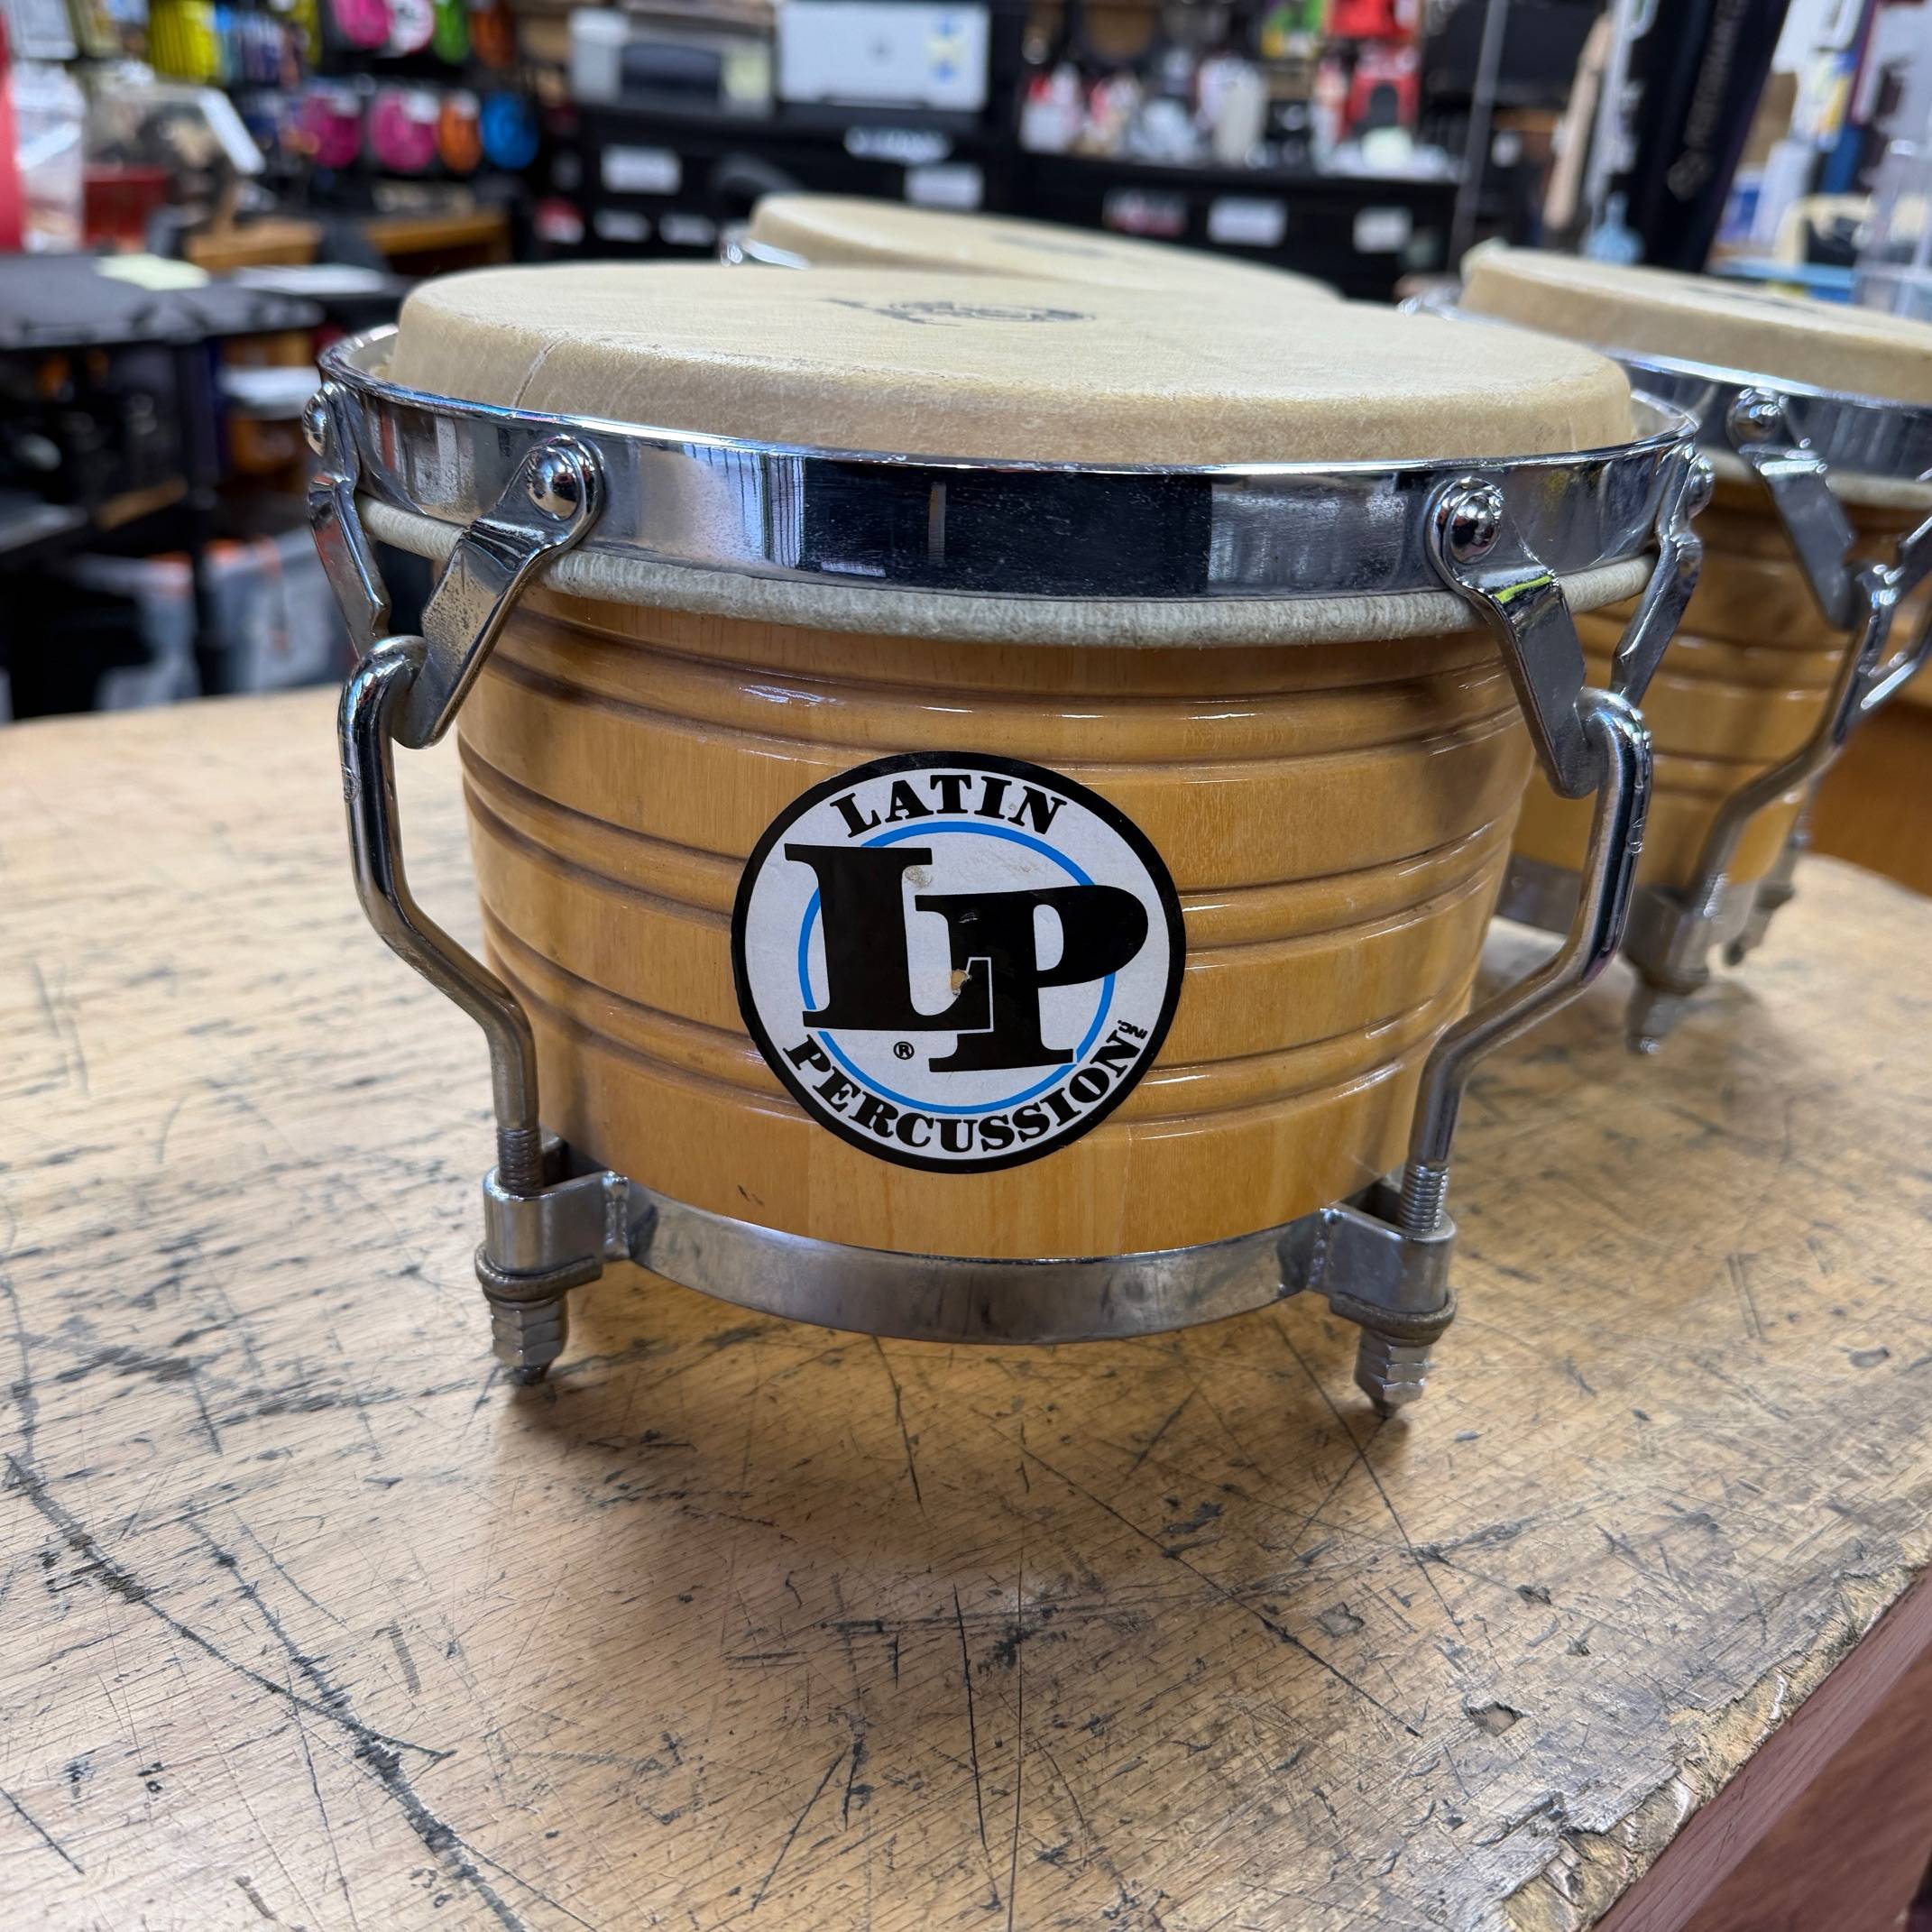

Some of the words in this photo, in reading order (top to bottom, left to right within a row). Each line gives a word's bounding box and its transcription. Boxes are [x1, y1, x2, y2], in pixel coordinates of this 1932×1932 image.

[830, 774, 1067, 838] LATIN
[784, 842, 1149, 1072] LP
[783, 1029, 1140, 1153] PERCUSSION
